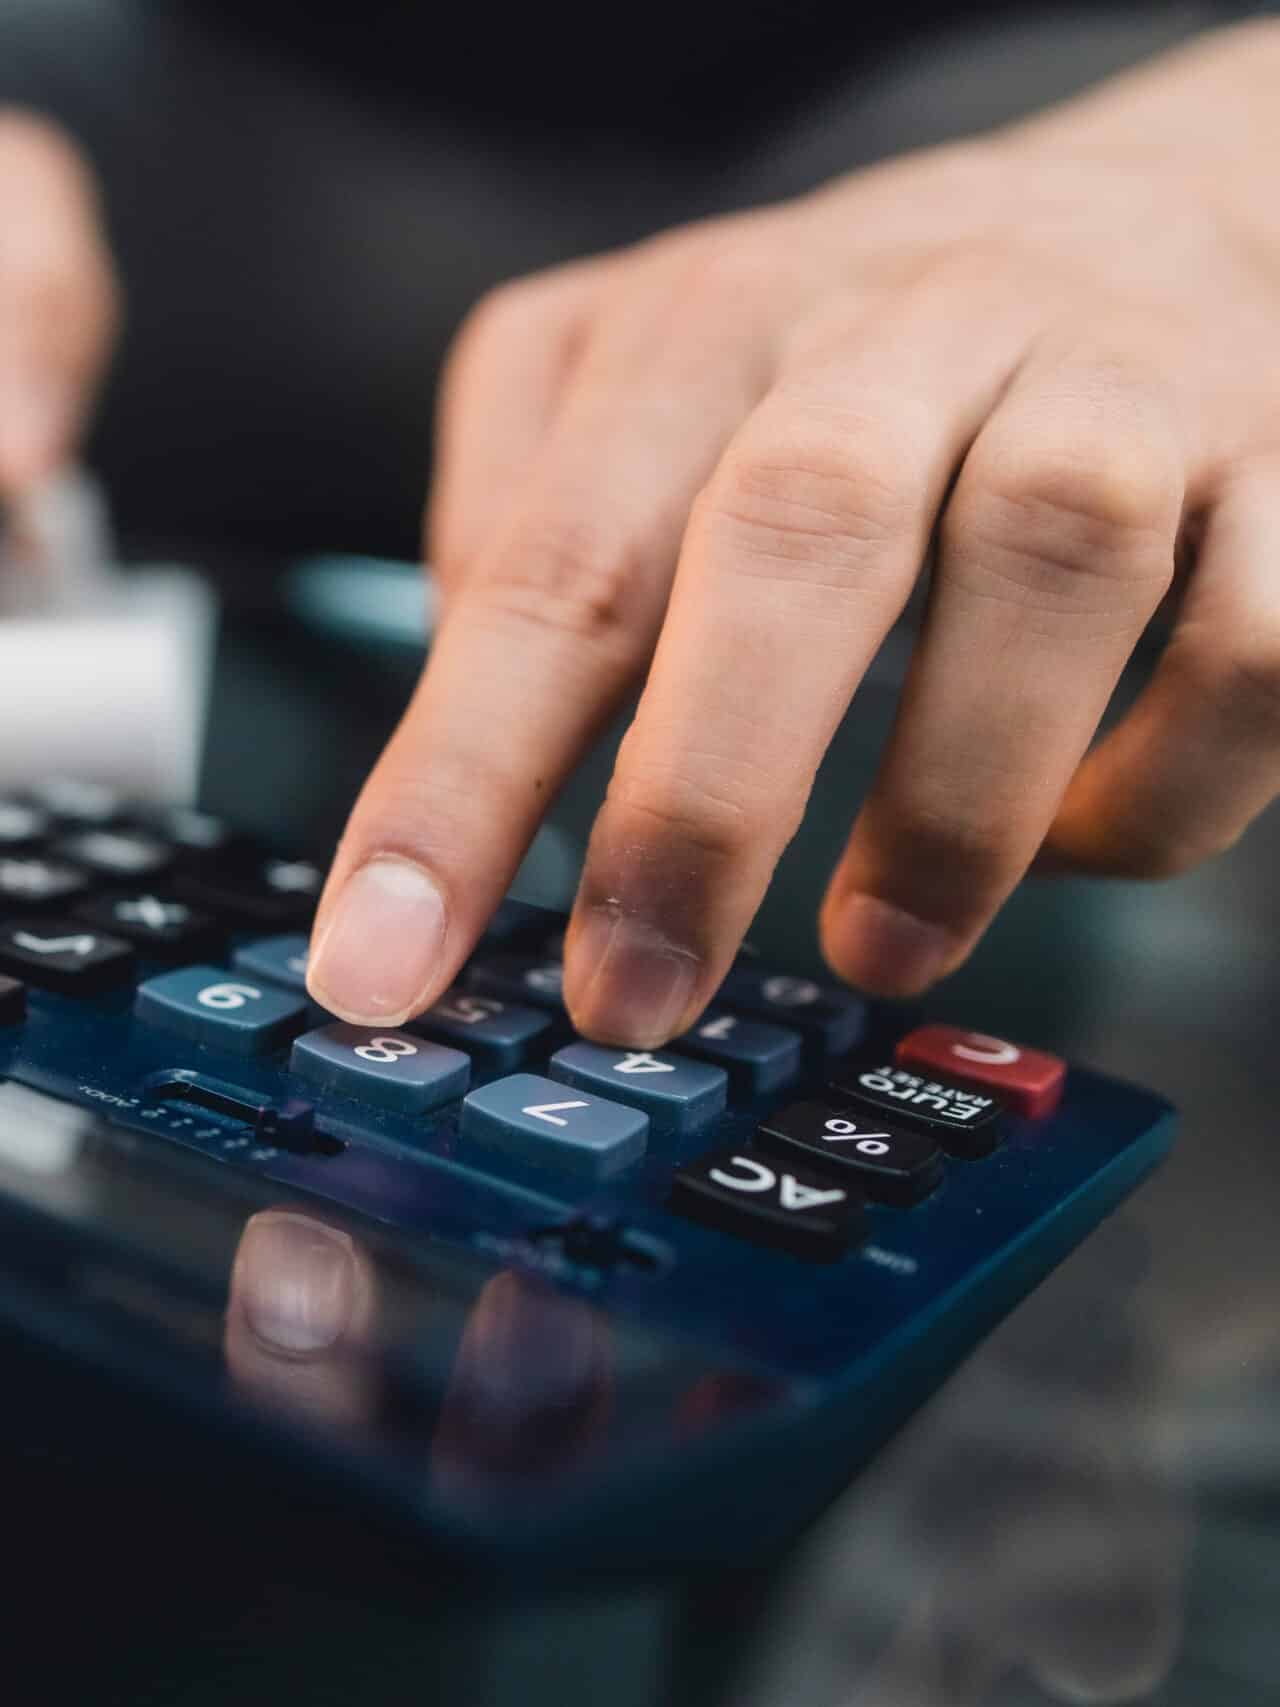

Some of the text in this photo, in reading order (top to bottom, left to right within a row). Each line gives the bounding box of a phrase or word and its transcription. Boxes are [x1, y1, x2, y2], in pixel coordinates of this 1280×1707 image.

[197, 983, 262, 1009] 9
[439, 998, 505, 1023] 5
[699, 1015, 736, 1040] 1
[352, 1036, 419, 1063] 8
[951, 1032, 1021, 1065] C
[612, 1051, 676, 1075] 4
[858, 1073, 984, 1122] Euro
[924, 1080, 993, 1106] RATE
[521, 1100, 590, 1127] 7
[821, 1118, 892, 1155] %
[709, 1156, 848, 1211] AC
